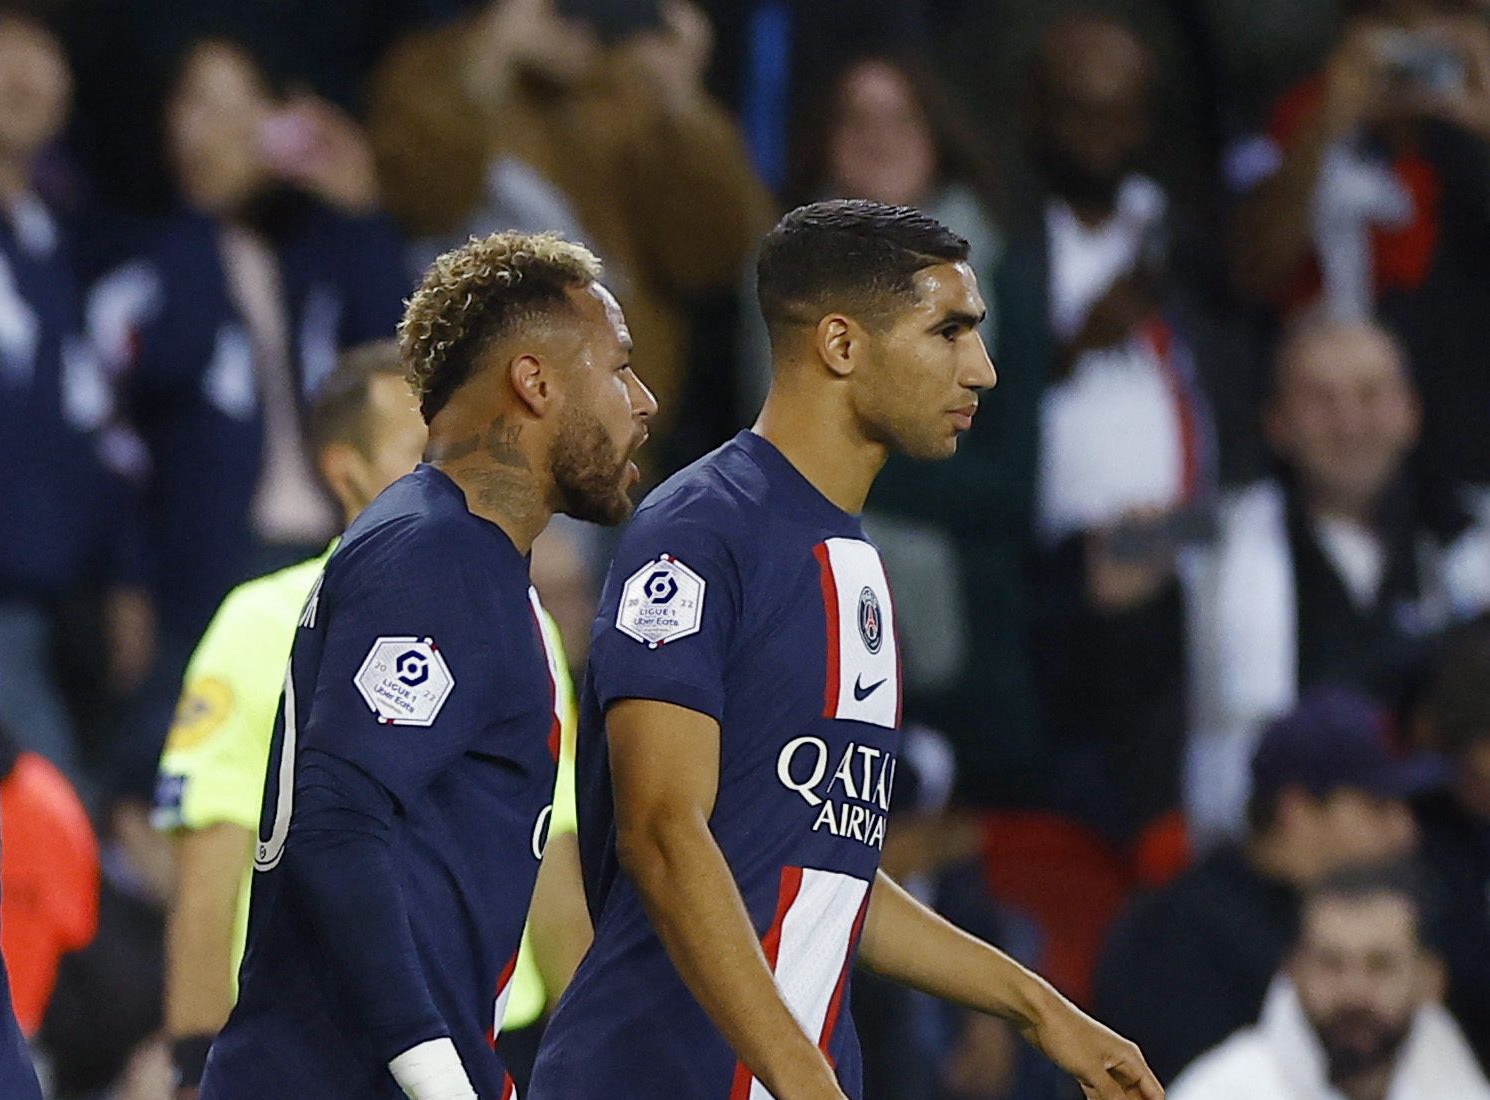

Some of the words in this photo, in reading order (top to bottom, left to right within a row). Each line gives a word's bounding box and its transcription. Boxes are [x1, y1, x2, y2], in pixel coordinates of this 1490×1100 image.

[634, 616, 655, 626] Uber
[656, 617, 680, 627] Eats
[640, 608, 669, 616] LIGUE
[372, 683, 395, 701] Uber
[393, 696, 416, 714] Eats
[382, 678, 411, 699] LIGUE
[776, 736, 896, 812] QATA
